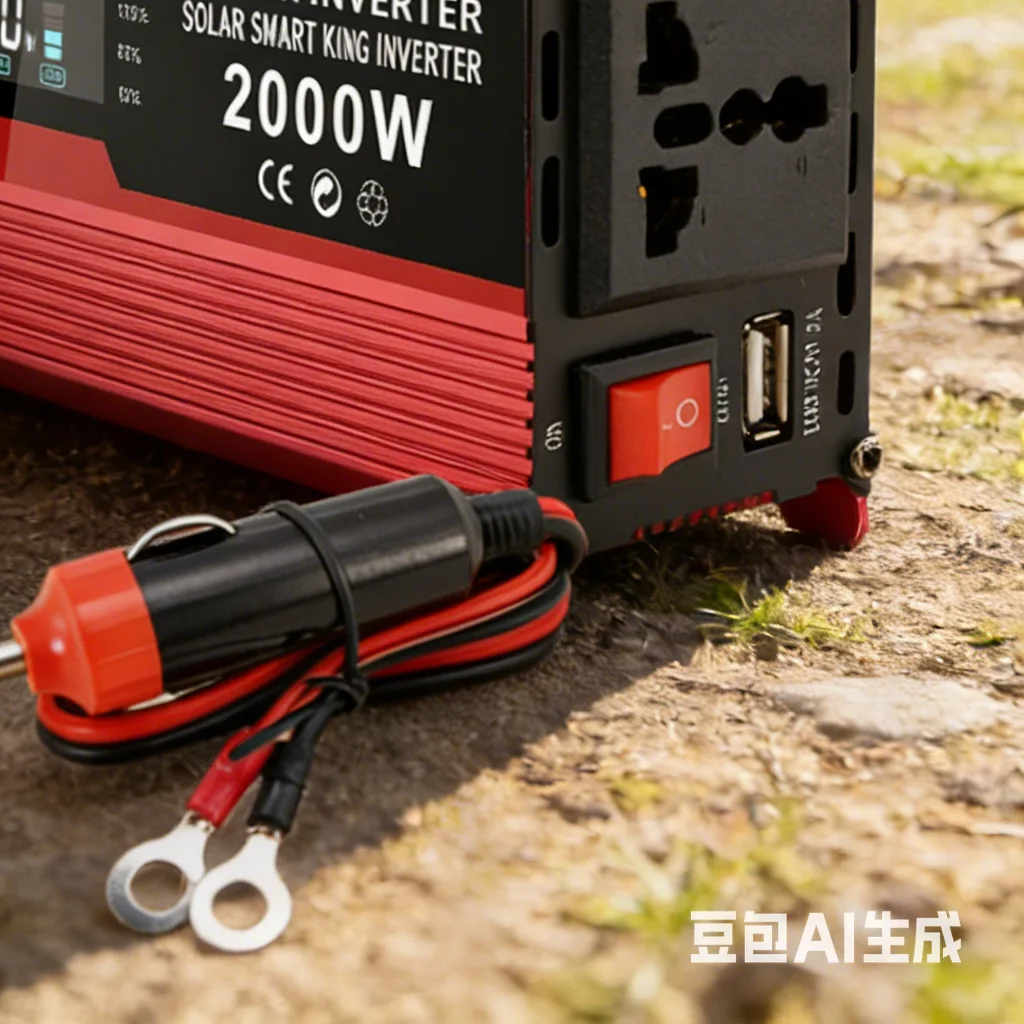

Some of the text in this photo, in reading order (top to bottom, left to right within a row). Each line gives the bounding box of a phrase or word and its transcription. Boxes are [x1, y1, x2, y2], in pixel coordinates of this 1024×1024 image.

[182, 0, 246, 42] SOLAR
[250, 10, 317, 55] SMART
[323, 25, 369, 65] KING
[376, 32, 483, 85] INVERTER
[222, 62, 433, 168] 2000W
[258, 159, 294, 205] CE
